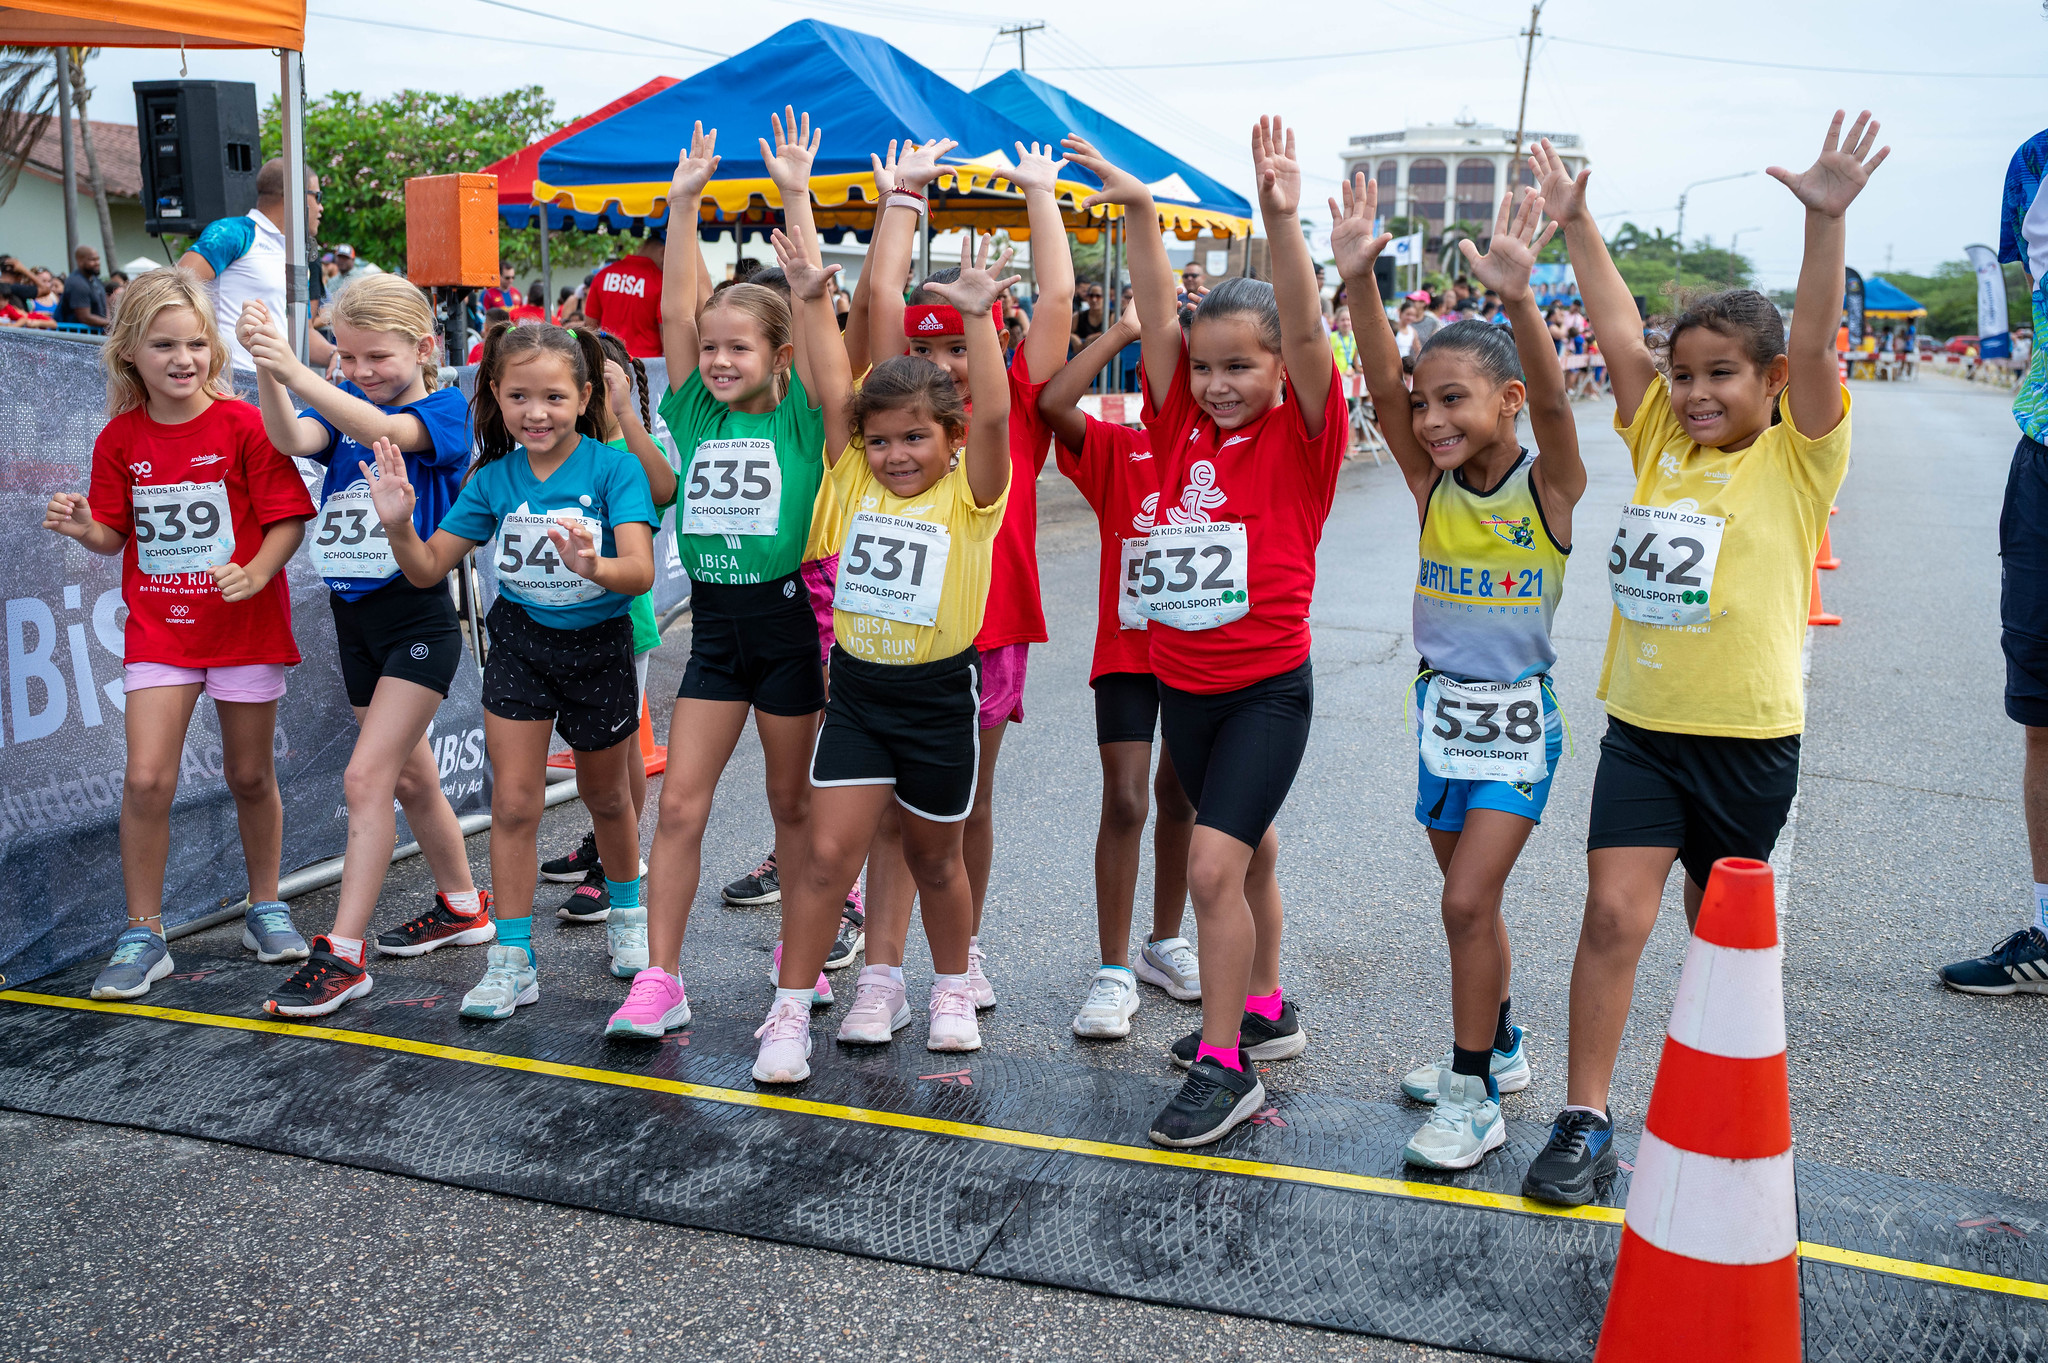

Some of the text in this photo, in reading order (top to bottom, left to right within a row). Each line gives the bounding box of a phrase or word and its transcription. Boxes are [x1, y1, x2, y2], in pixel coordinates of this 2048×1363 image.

[603, 272, 645, 298] IBiSA
[918, 323, 943, 331] adidas
[750, 441, 770, 449] 2025
[687, 460, 772, 500] 535
[148, 487, 168, 495] KIDS
[169, 485, 189, 493] RUN
[691, 507, 760, 516] SCHOOLSPORT
[1630, 507, 1651, 517] KIDS
[1653, 510, 1677, 520] RUN
[1680, 514, 1706, 525] 2025
[134, 501, 221, 543] 539
[875, 516, 893, 525] KIDS
[894, 519, 913, 528] RUN
[915, 522, 937, 533] 2025
[1161, 528, 1182, 536] KIDS
[1184, 526, 1205, 534] RUN
[1207, 524, 1231, 532] 2025
[145, 544, 213, 557] SCHOOLSPORT
[323, 552, 388, 560] SCHOOLSPORT
[498, 533, 577, 574] 54
[1609, 527, 1705, 587] 542
[700, 553, 739, 570] IBiSA
[846, 533, 928, 587] 531
[150, 572, 181, 585] KIDS
[1141, 545, 1234, 595] 532
[1420, 558, 1543, 598] URTLE & 21
[162, 586, 177, 594] Race,
[845, 582, 916, 602] SCHOOLSPORT
[1614, 583, 1682, 603] SCHOOLSPORT
[1150, 598, 1222, 611] SCHOOLSPORT
[1418, 594, 1540, 615] THLETIC ARUBA
[853, 616, 892, 635] IBiSA
[1686, 625, 1711, 633] Pace!
[882, 639, 916, 655] RUN
[1512, 680, 1532, 689] 2025
[1432, 696, 1542, 744] 538
[1443, 747, 1529, 761] SCHOOLSPORT
